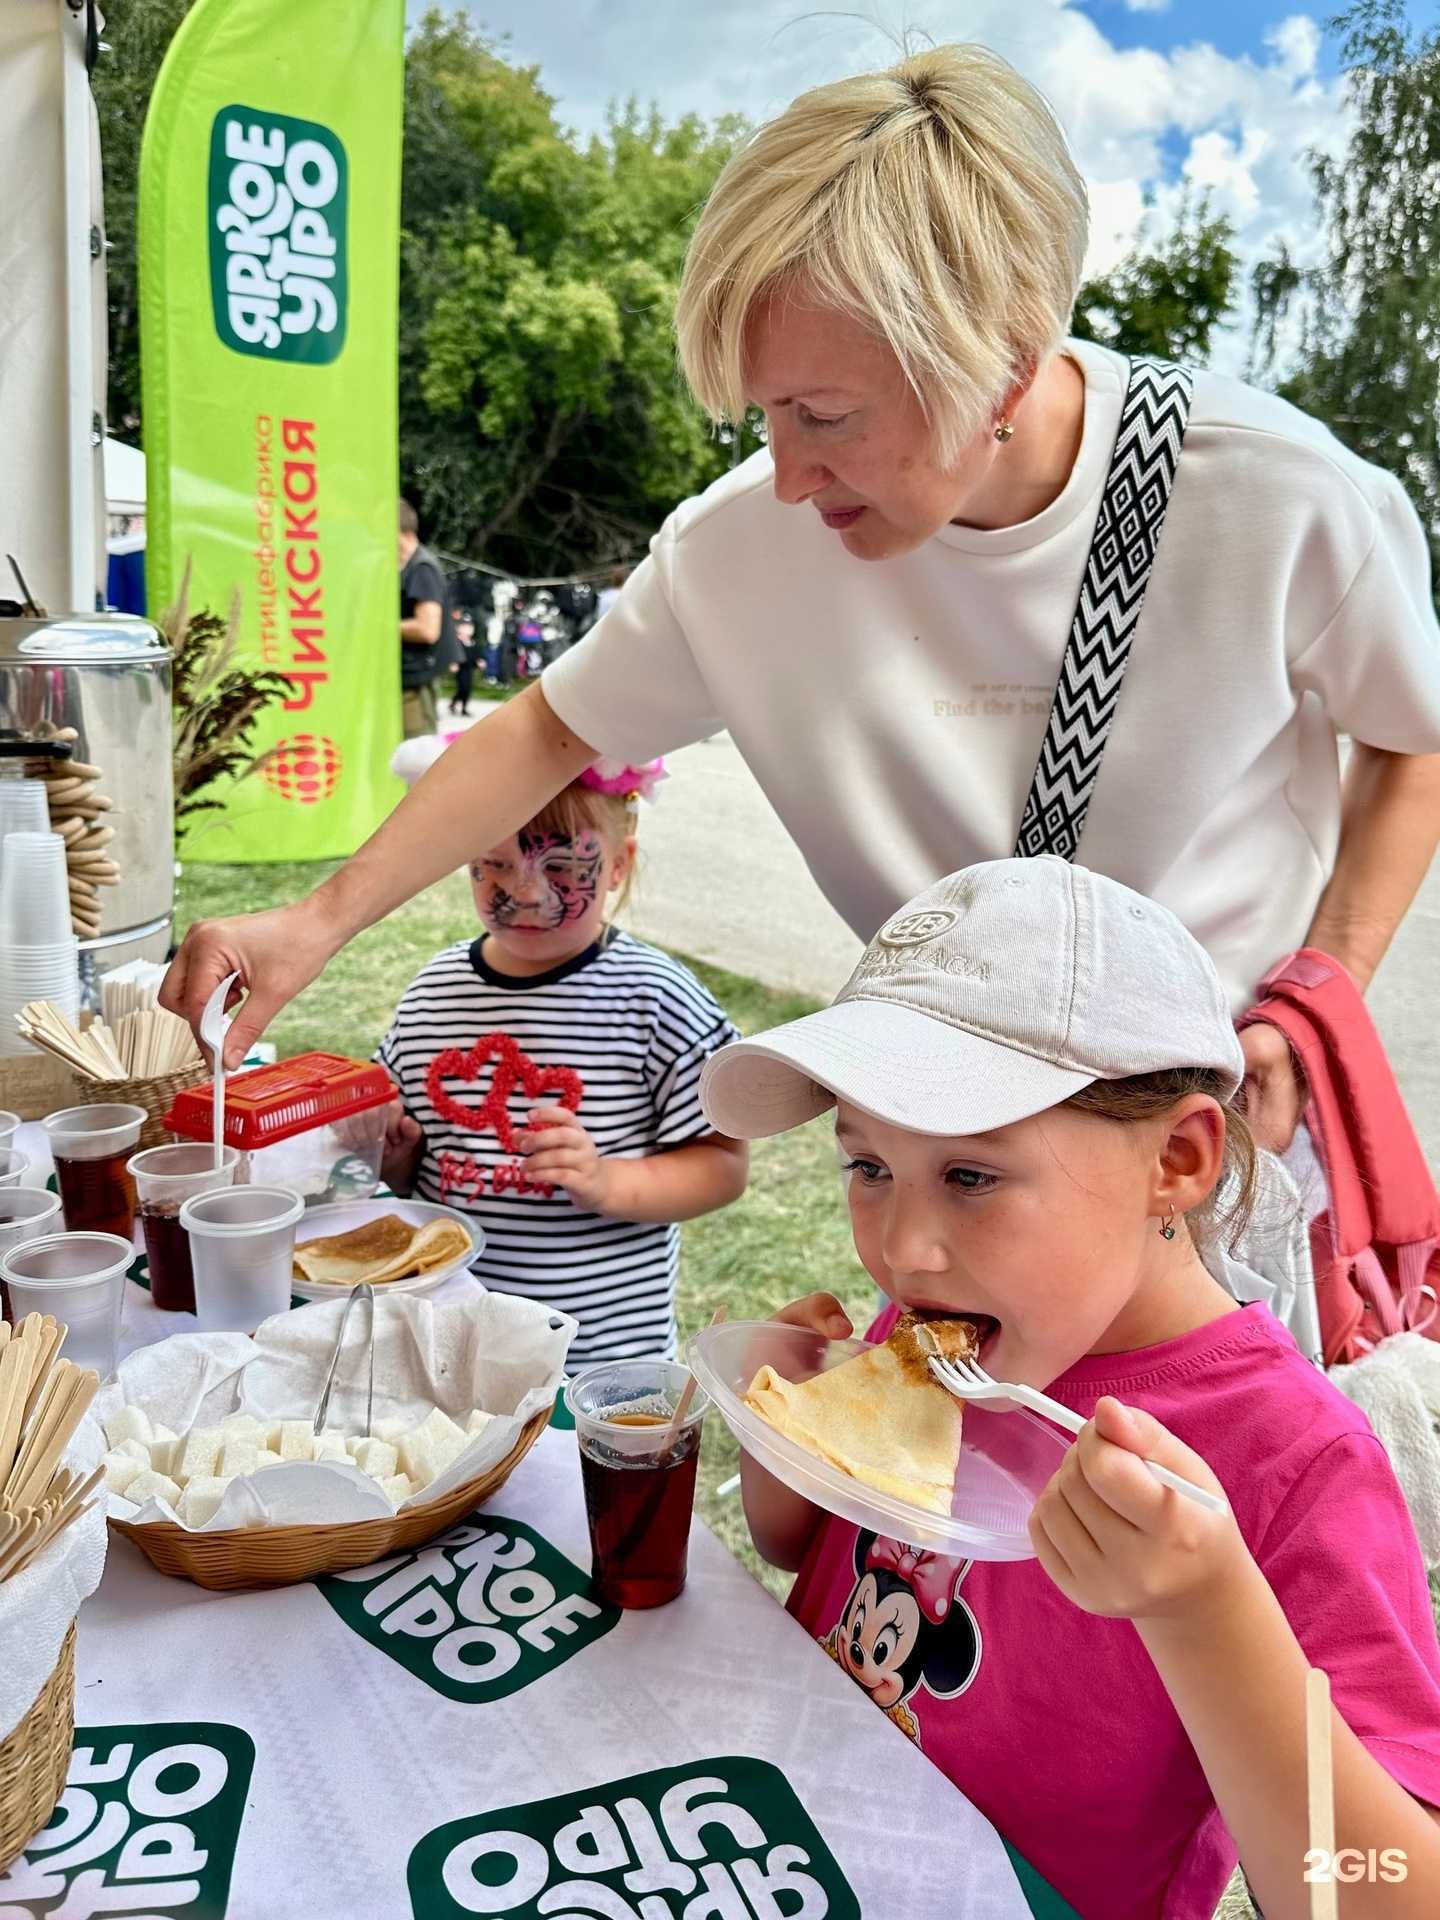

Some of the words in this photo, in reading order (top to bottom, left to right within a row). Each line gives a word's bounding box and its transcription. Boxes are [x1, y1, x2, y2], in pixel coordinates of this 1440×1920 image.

[255, 414, 280, 665] птицефабрика
[281, 418, 329, 712] Чикская
[421, 1525, 602, 1653] РКОЕ
[44, 1743, 229, 1920] ТРО
